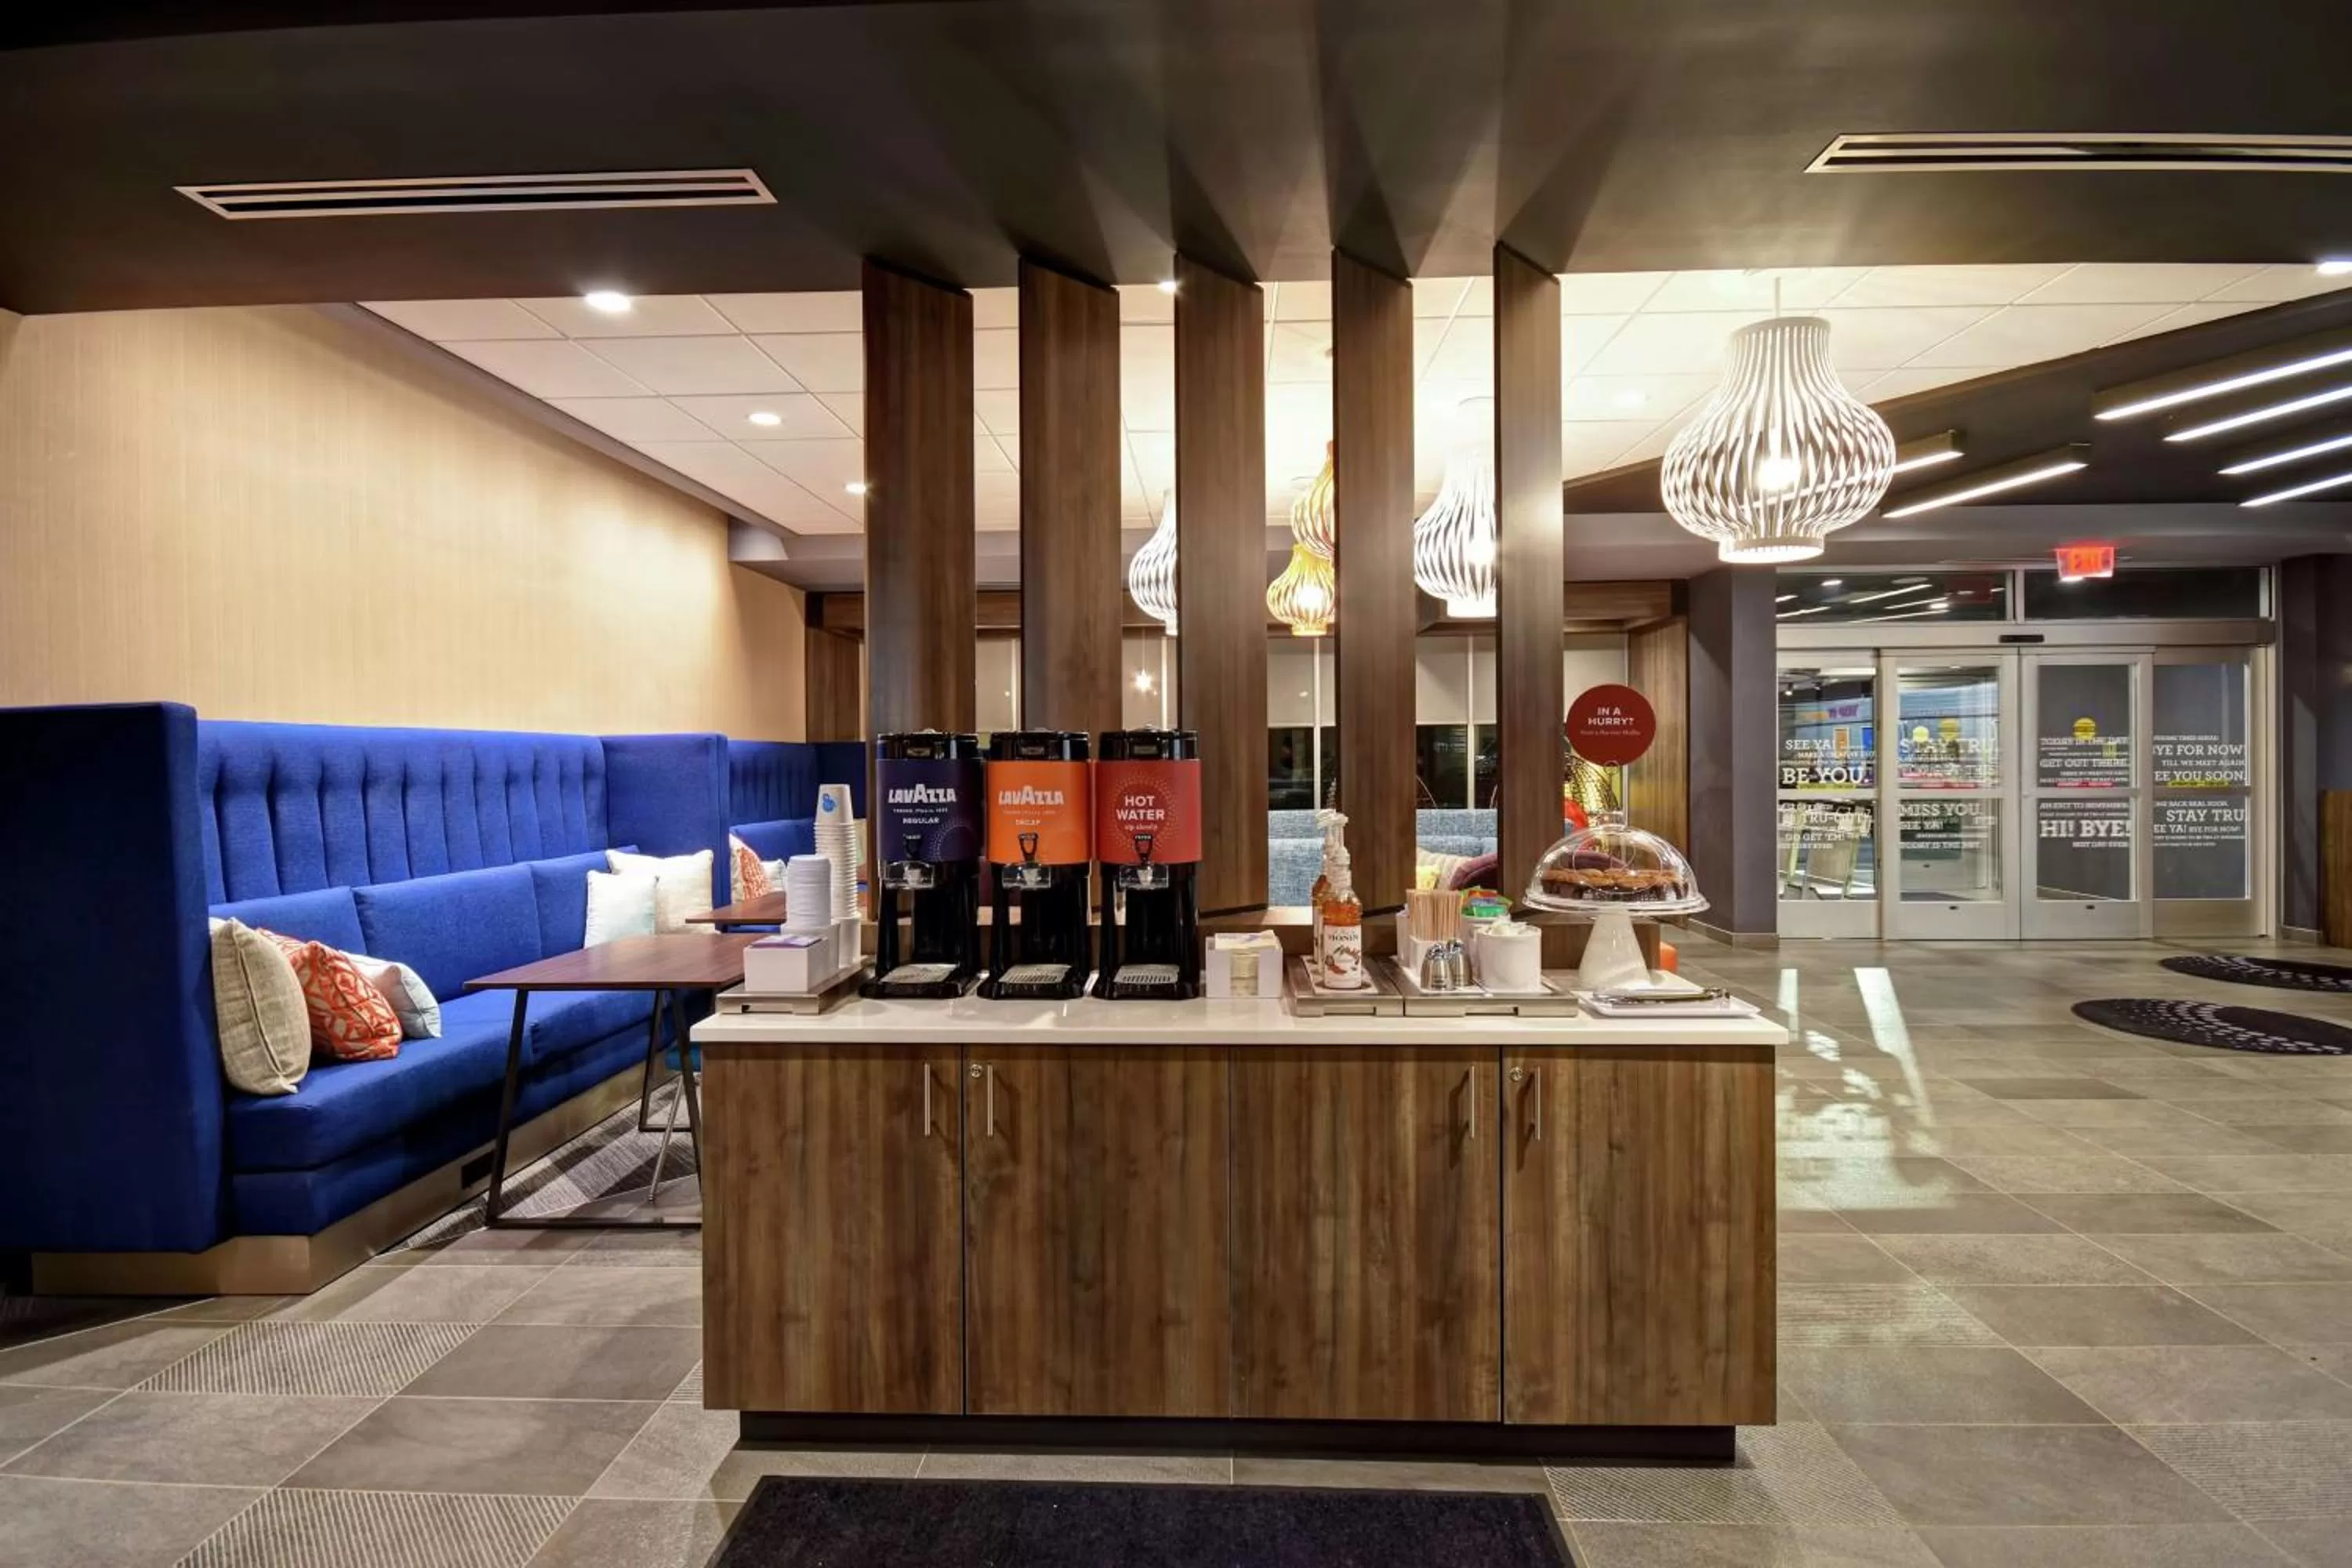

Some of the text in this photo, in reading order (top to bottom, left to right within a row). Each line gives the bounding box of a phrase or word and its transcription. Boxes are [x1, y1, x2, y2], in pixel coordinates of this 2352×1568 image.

[1597, 706, 1621, 716] IN A
[1588, 717, 1635, 726] HURRY?
[1785, 739, 1810, 750] SEE
[2176, 744, 2204, 755] FOR
[2039, 758, 2063, 768] GET
[2064, 758, 2089, 768] OUT
[1781, 766, 1870, 785] BE YOU.
[2173, 770, 2202, 782] YOU
[887, 783, 956, 804] LAVAZZA
[998, 785, 1065, 805] LAVAZZA
[1124, 795, 1155, 807] HOT
[1116, 808, 1165, 821] WATER
[1898, 803, 1940, 816] MISS
[2166, 808, 2208, 822] STAY
[2039, 819, 2132, 838] HI! BYE!
[2169, 824, 2187, 833] YA!
[1803, 833, 1822, 841] GET
